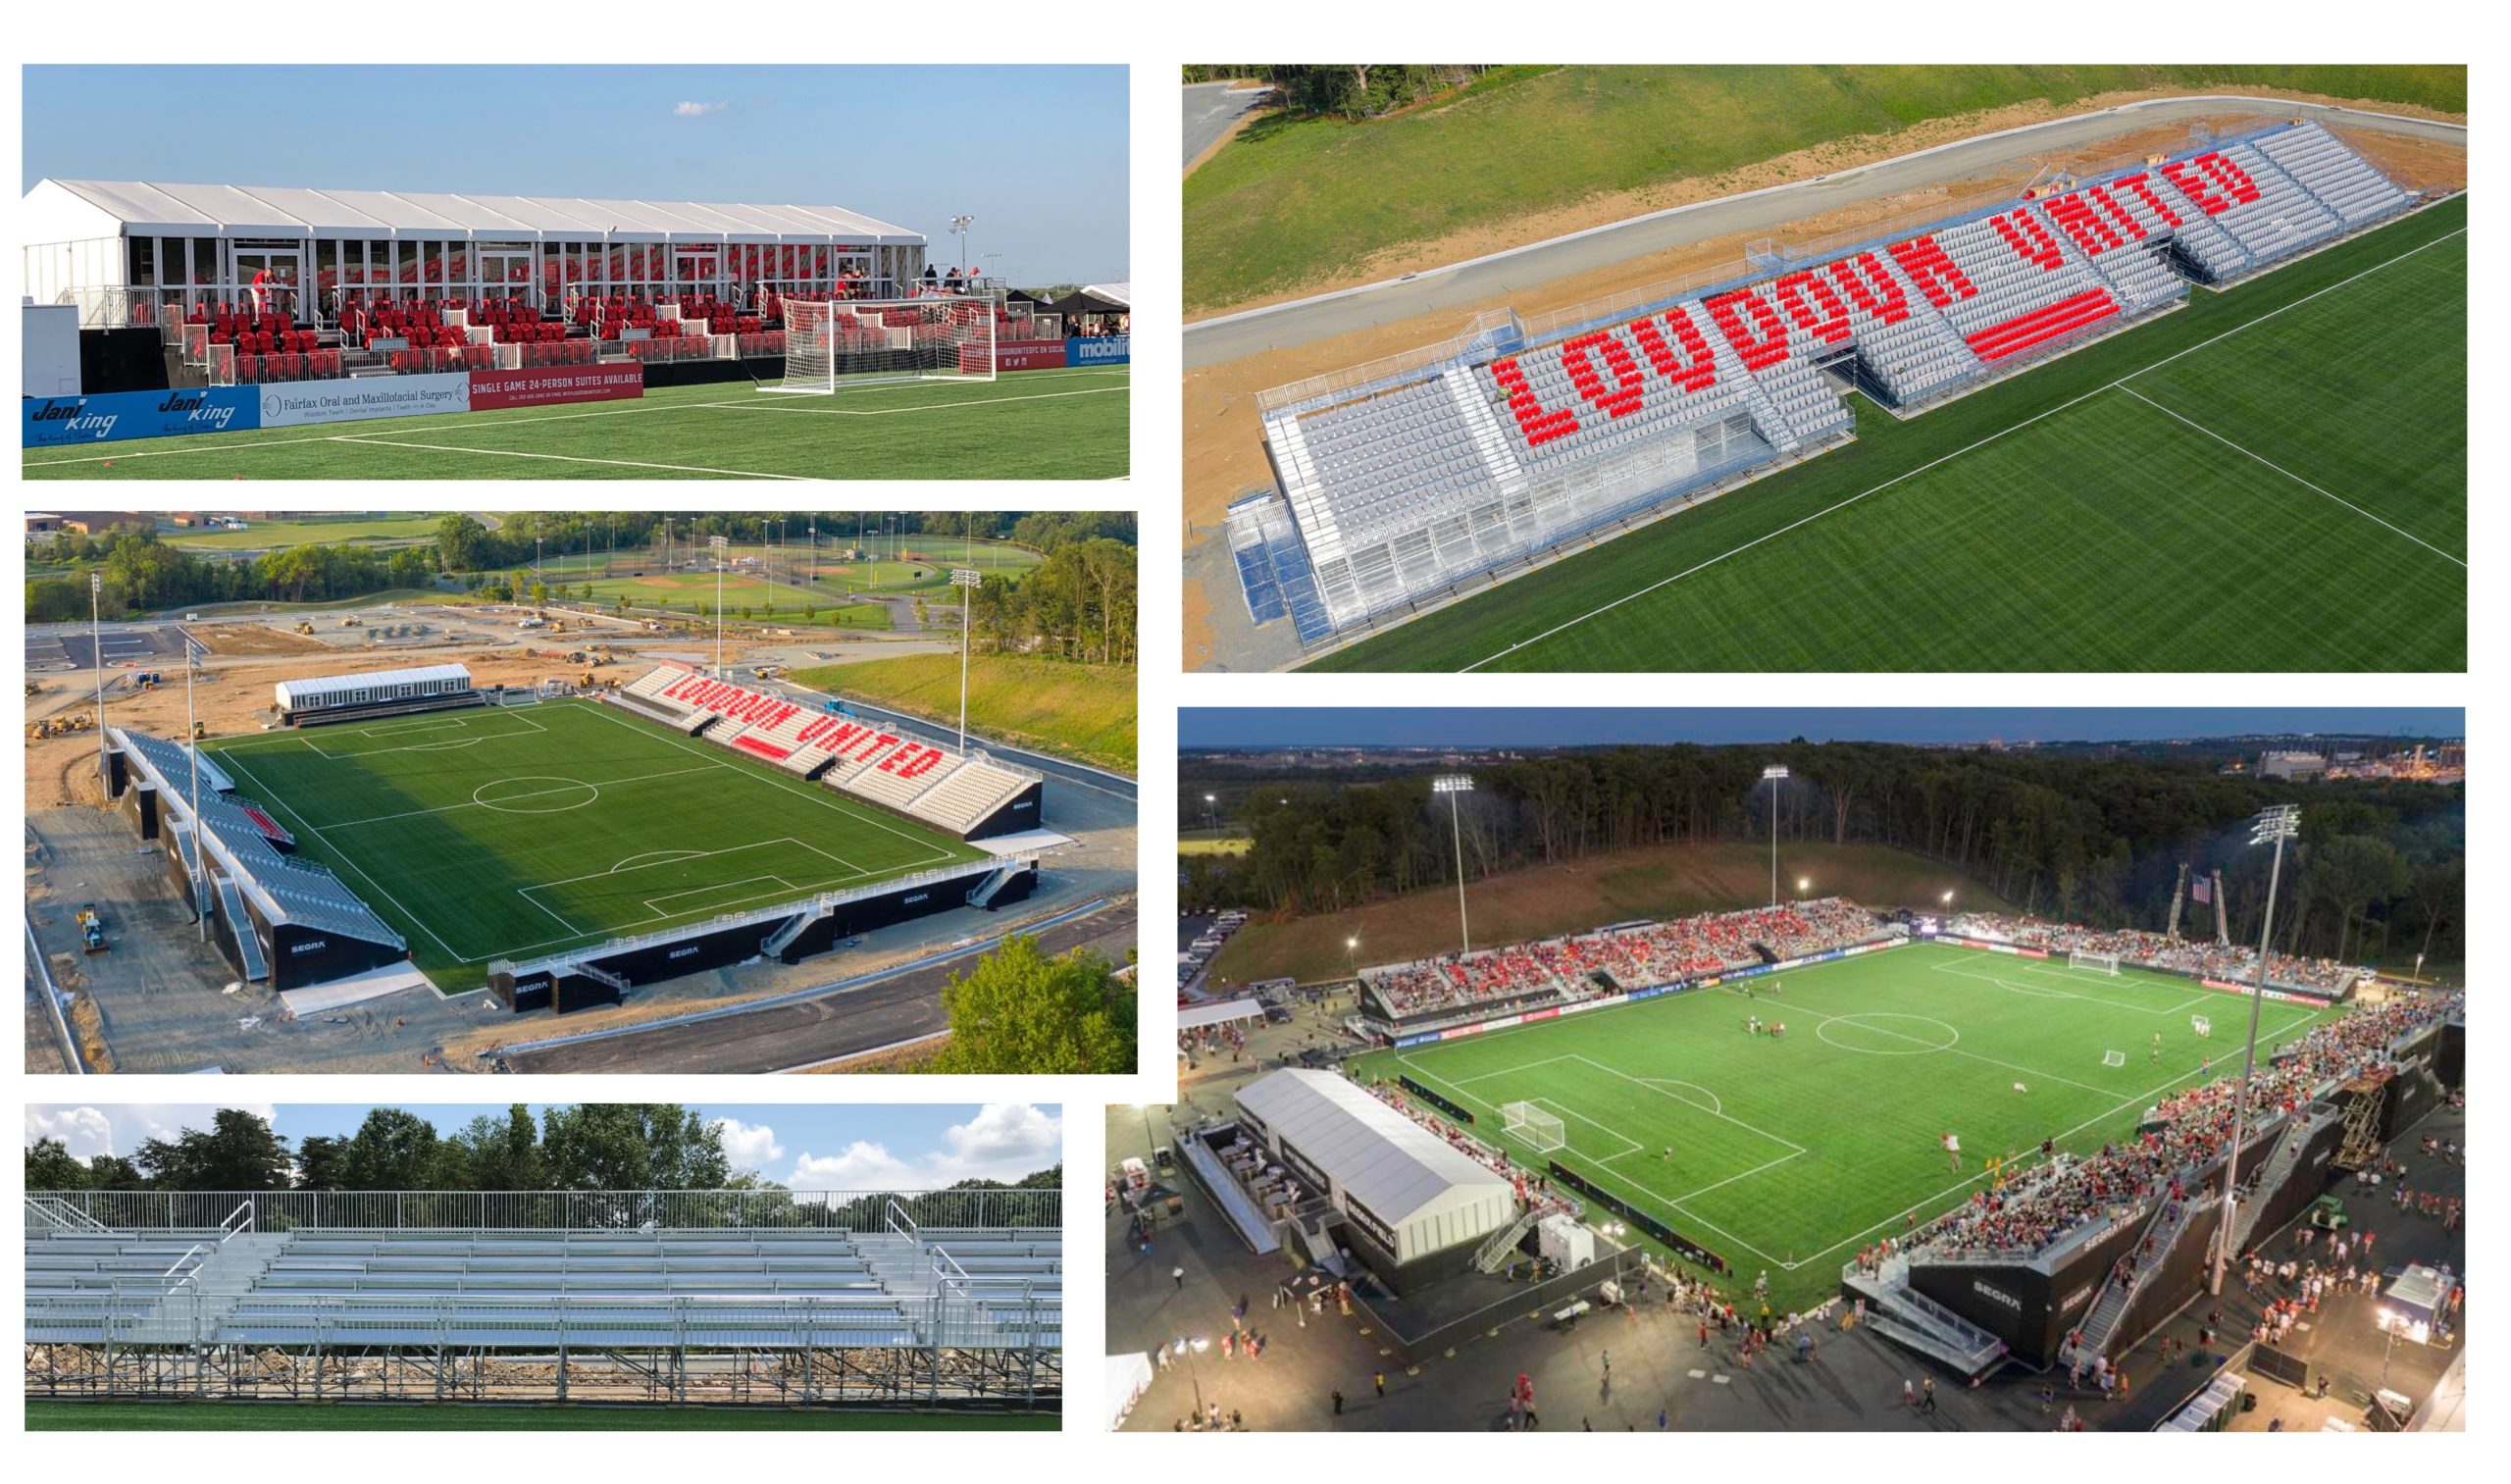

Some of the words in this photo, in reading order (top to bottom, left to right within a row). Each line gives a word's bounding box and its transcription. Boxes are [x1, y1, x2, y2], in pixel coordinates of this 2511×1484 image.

[1989, 151, 2261, 272] UNITED
[1049, 344, 1066, 353] SOCIAL
[472, 382, 501, 394] SINGLE
[504, 381, 527, 392] GAME
[529, 378, 573, 389] 24-PERSON
[576, 376, 601, 386] SUITES
[603, 373, 643, 384] AVAILABLE
[158, 392, 208, 413] Jani
[283, 397, 318, 410] Fairfax
[320, 394, 340, 408] Oral
[343, 392, 360, 405] and
[362, 389, 419, 404] Maxillofacial
[420, 388, 454, 402] Surgery
[32, 399, 86, 422] Jani
[187, 403, 235, 429] king
[64, 413, 119, 438] king
[663, 674, 801, 731] LOUDOUN
[795, 715, 944, 780] UNITED
[290, 940, 327, 953] SEGRA
[668, 946, 699, 959] SEGRA
[515, 981, 549, 995] SEGRA
[1973, 1280, 2023, 1312] SEGRA
